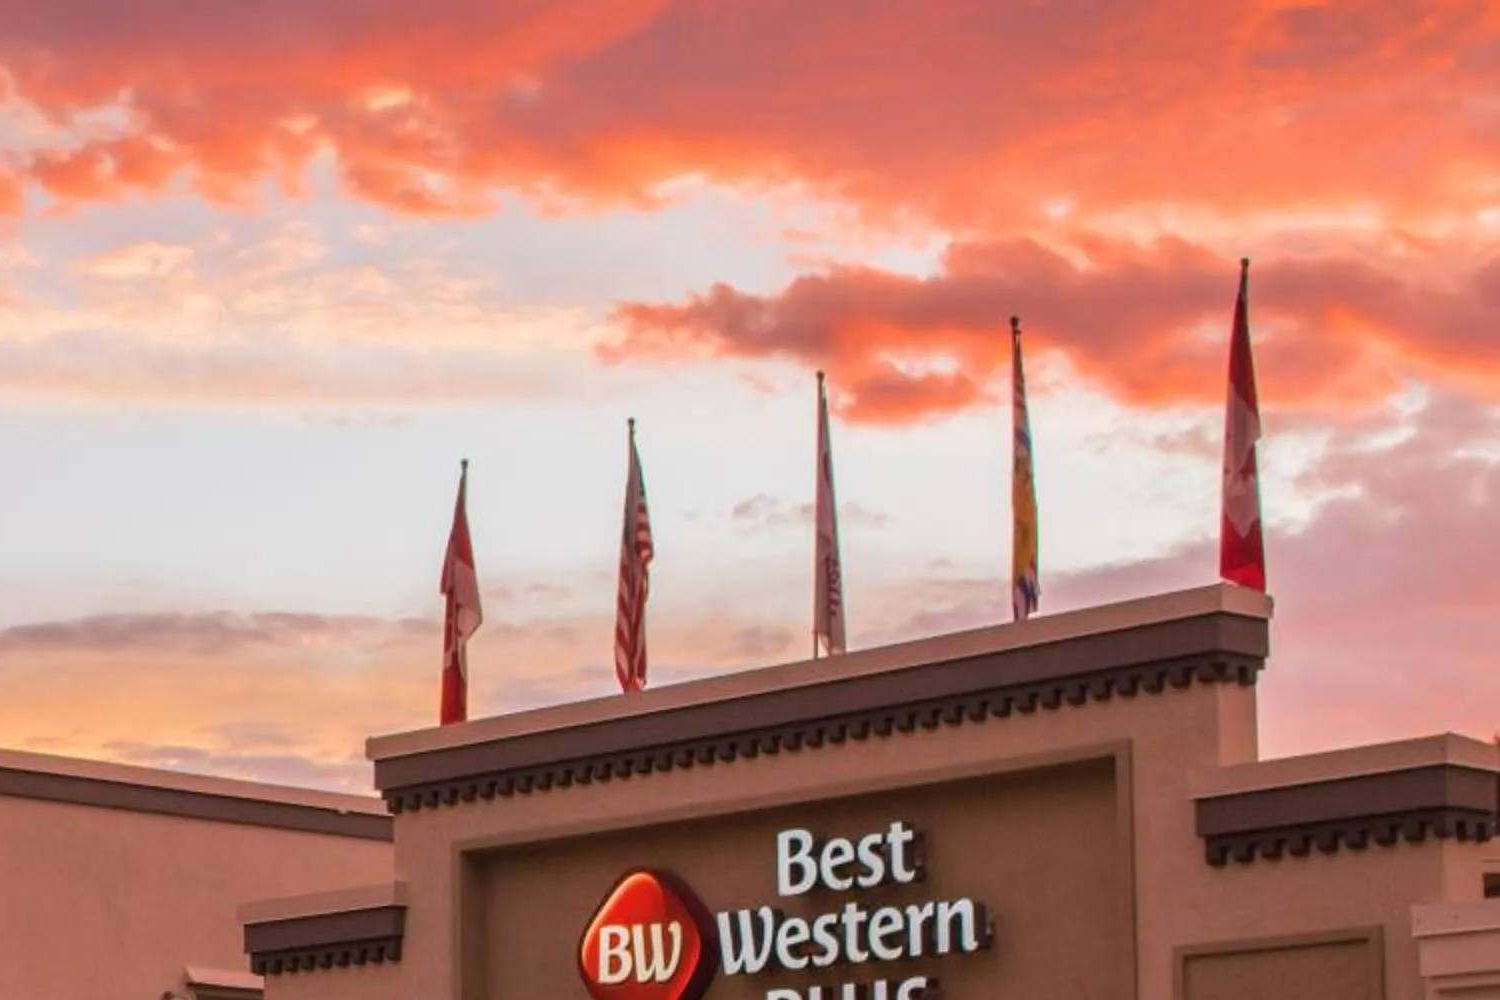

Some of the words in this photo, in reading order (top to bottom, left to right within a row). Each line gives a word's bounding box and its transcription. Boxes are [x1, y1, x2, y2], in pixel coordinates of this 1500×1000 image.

[776, 821, 916, 896] Best
[599, 920, 682, 984] BW
[717, 897, 980, 976] Western
